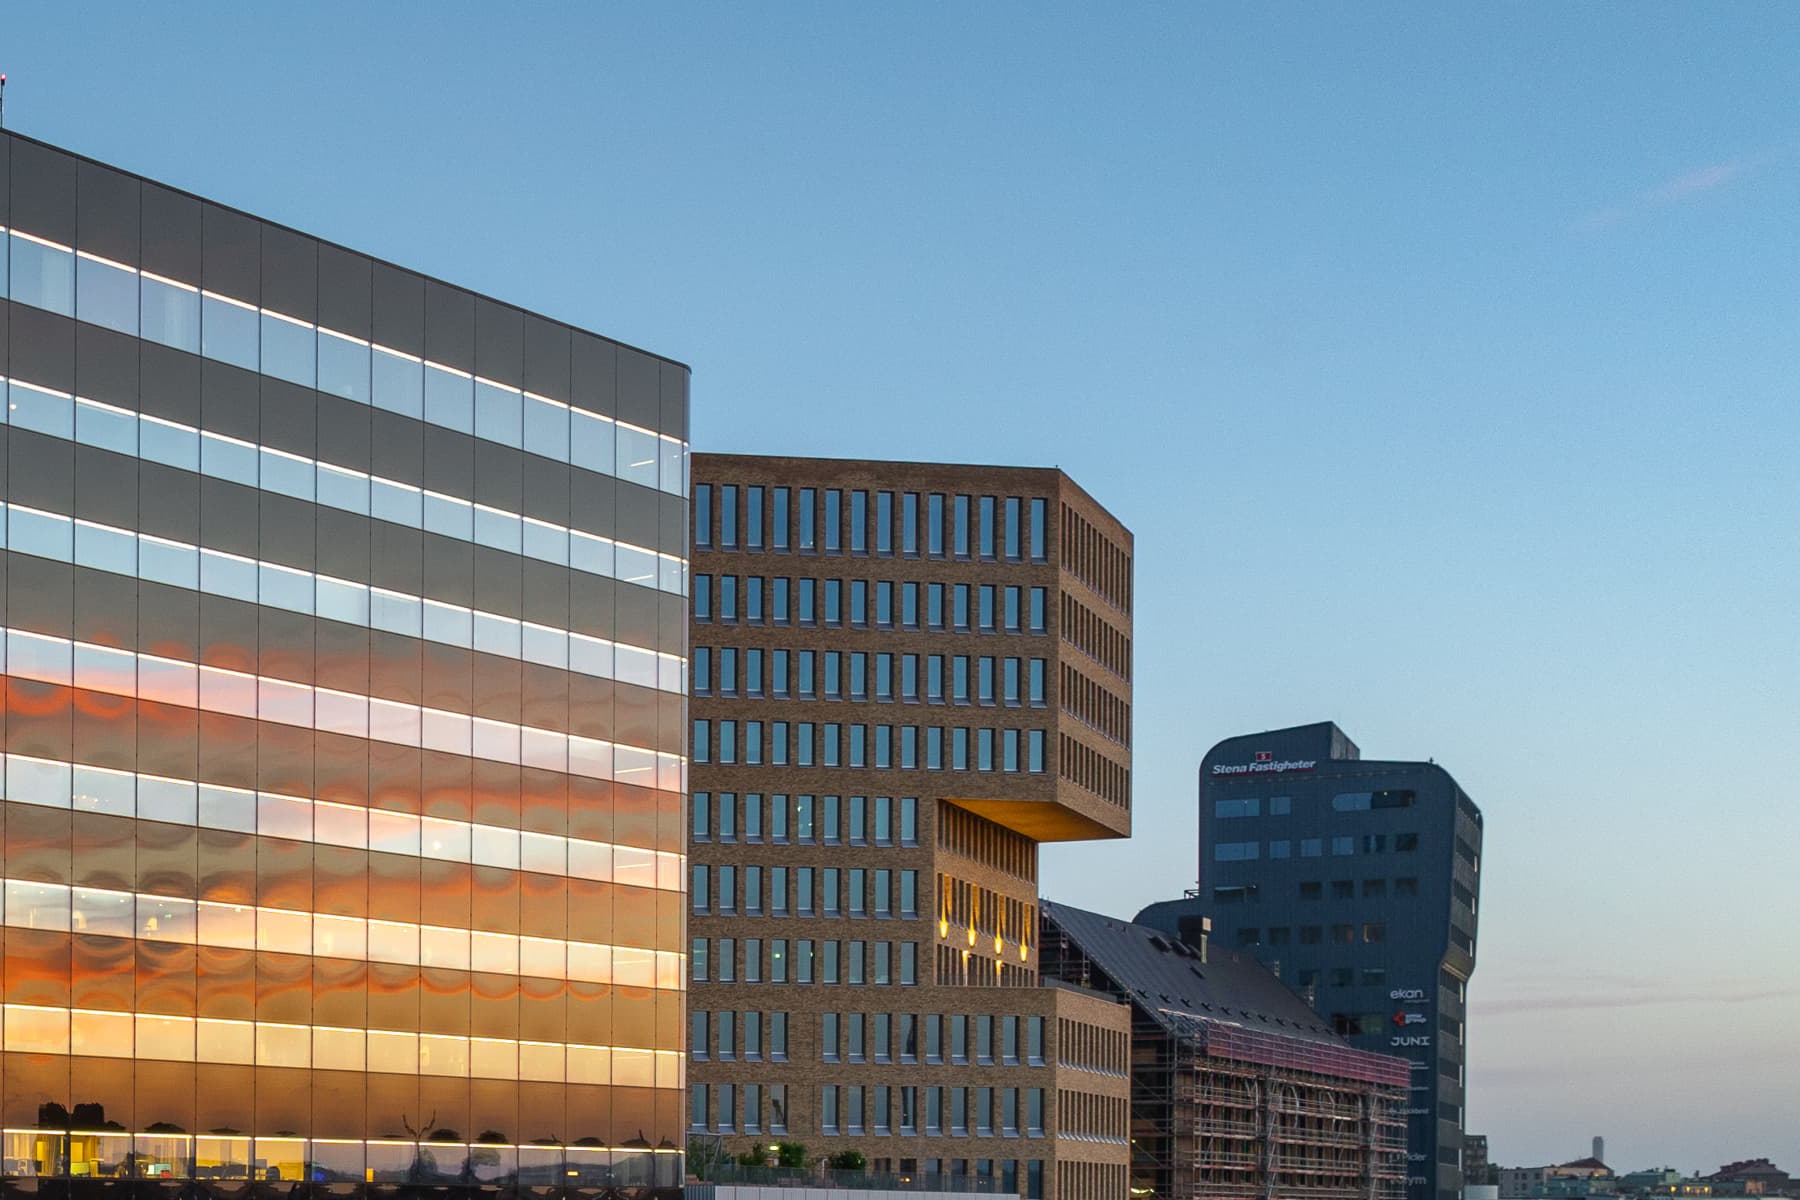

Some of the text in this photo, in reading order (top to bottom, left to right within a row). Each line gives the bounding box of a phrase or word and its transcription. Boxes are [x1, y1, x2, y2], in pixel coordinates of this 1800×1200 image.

[1212, 760, 1316, 774] Stena Fastigheter
[1390, 989, 1423, 999] ekan
[1391, 1036, 1430, 1046] JUNI
